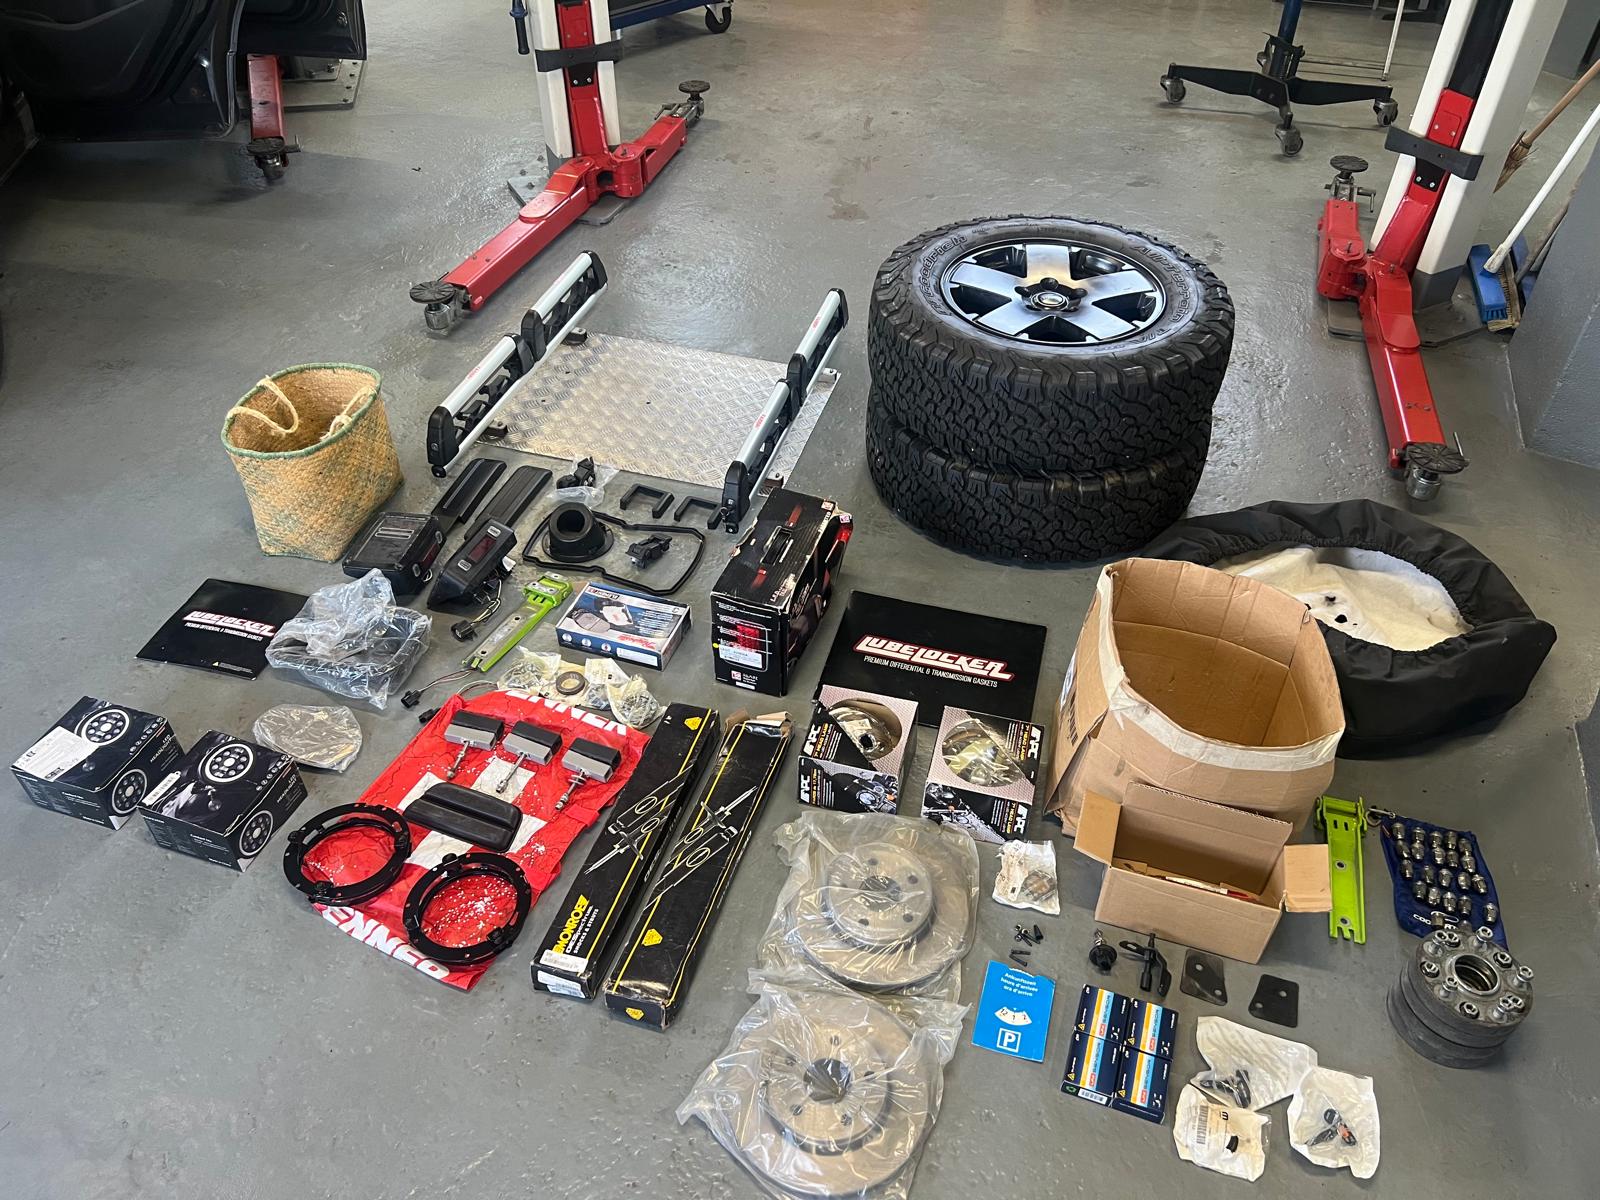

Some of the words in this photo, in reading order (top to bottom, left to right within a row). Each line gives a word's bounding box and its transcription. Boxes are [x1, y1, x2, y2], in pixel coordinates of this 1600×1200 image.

[855, 635, 1013, 681] LUBELOCKER
[864, 655, 889, 667] PREMIUM
[889, 659, 925, 674] DIFFERENTIAL
[931, 669, 972, 683] TRANSMISSION
[973, 676, 998, 688] GASKETS
[553, 896, 589, 952] MONROE
[573, 932, 587, 954] SHOCKS
[587, 908, 599, 927] STRUTS
[1003, 1031, 1016, 1047] P
